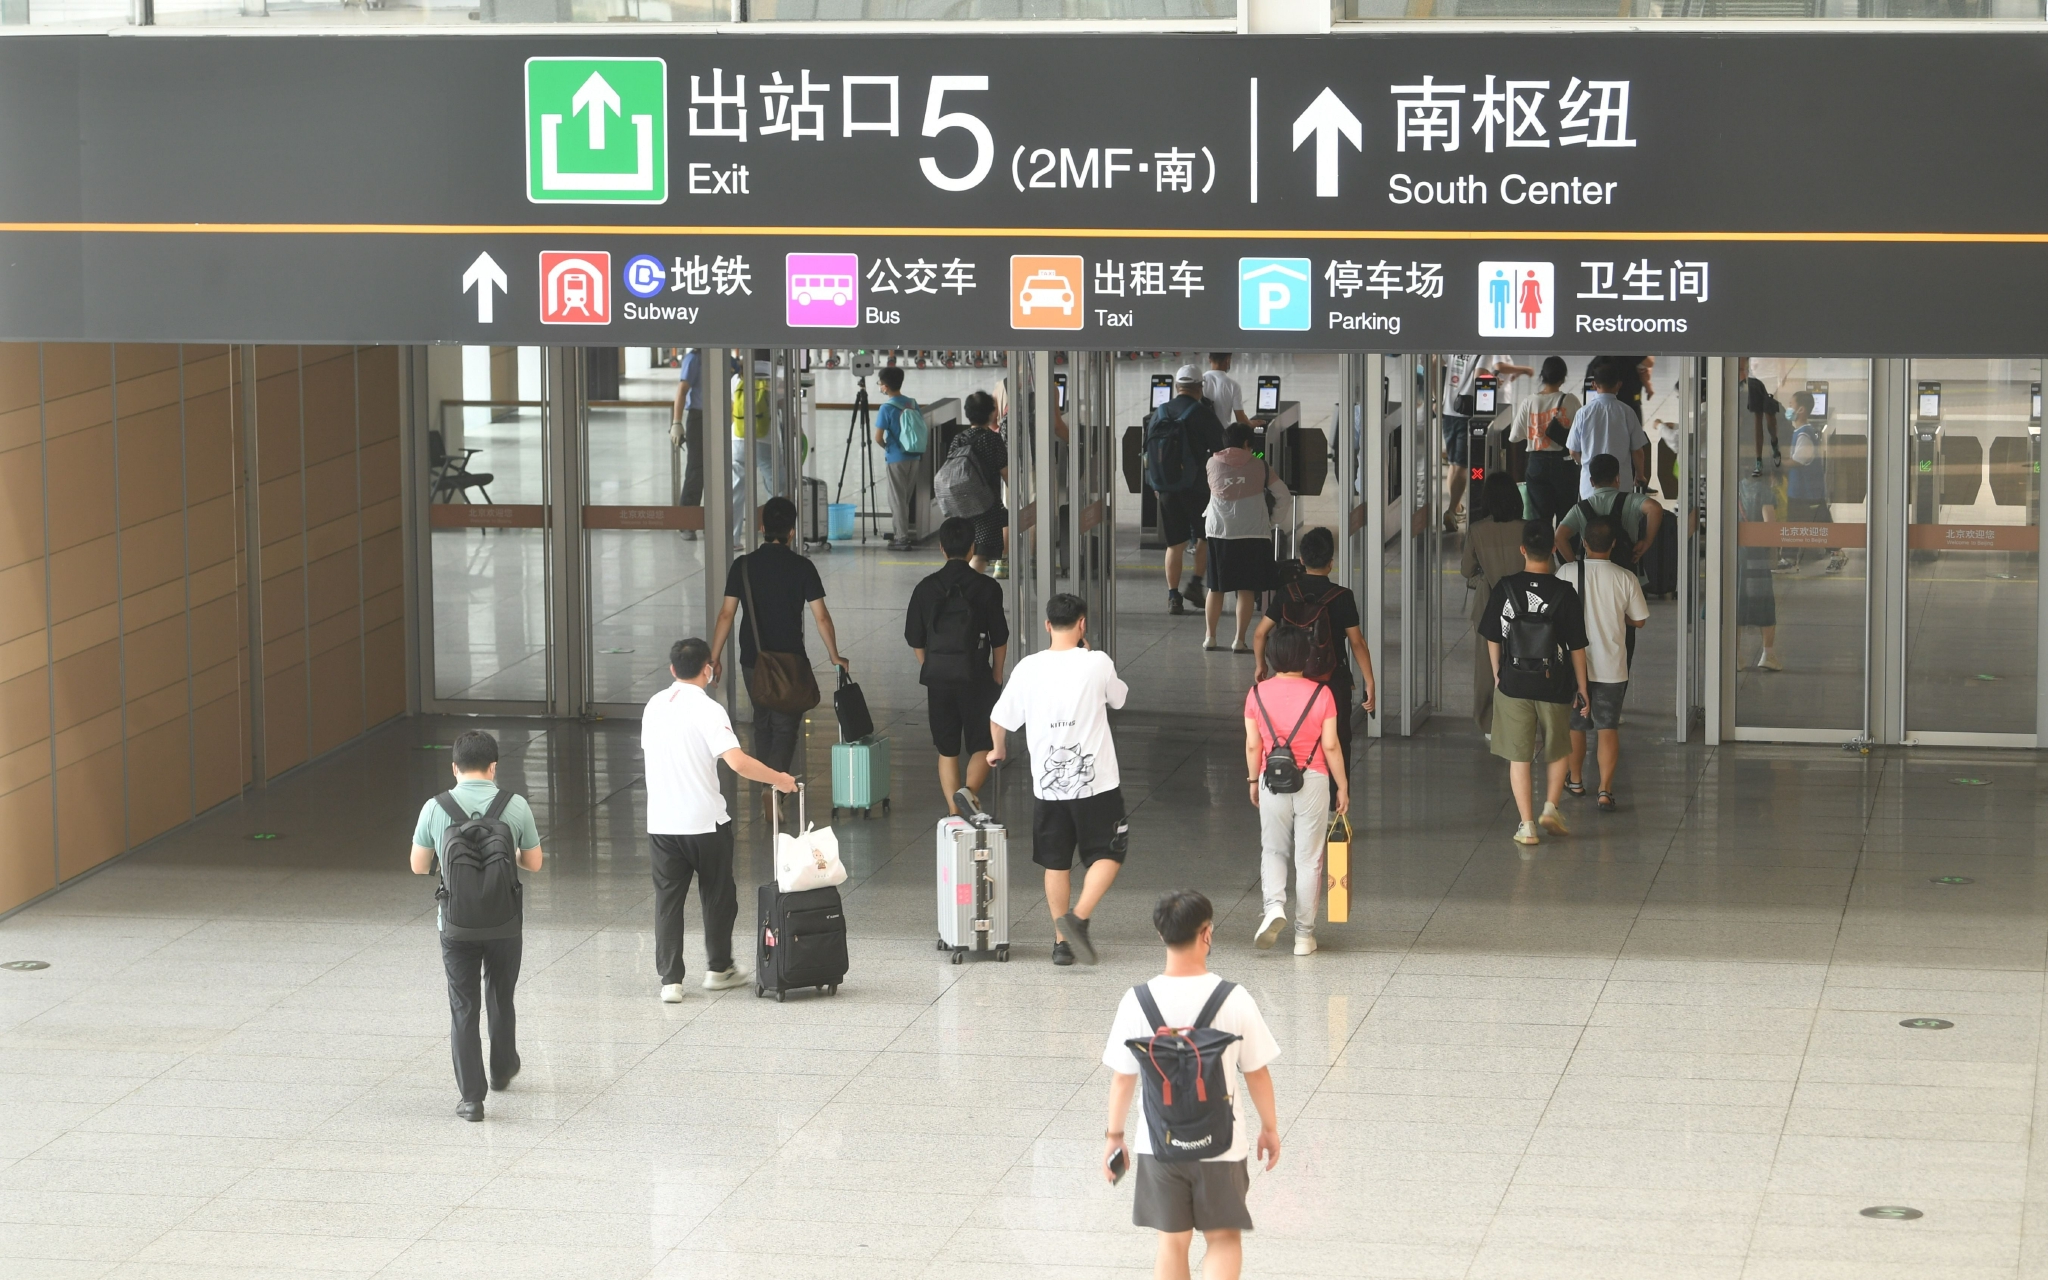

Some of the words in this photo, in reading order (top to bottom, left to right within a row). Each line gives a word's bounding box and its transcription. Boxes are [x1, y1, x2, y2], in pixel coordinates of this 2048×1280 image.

[1390, 74, 1637, 153] 南枢纽
[688, 67, 900, 142] 出站口
[919, 75, 995, 192] 5
[1011, 144, 1217, 194] (2MF·南)
[688, 162, 750, 195] Exit
[1388, 173, 1487, 205] South
[1500, 173, 1618, 205] Center
[670, 254, 753, 296] 地铁
[865, 257, 977, 296] 公交车
[1094, 258, 1205, 298] 出租车
[1323, 259, 1444, 300] 停车场
[1576, 258, 1709, 303] 卫生间
[623, 301, 700, 325] Subway
[865, 306, 901, 325] Bus
[1094, 309, 1133, 327] Taxi
[1259, 283, 1291, 324] P
[1328, 311, 1401, 335] Parking
[1575, 314, 1688, 333] Restrooms
[1780, 526, 1829, 537] 北京欢迎您
[1945, 529, 1995, 539] 北京欢迎您
